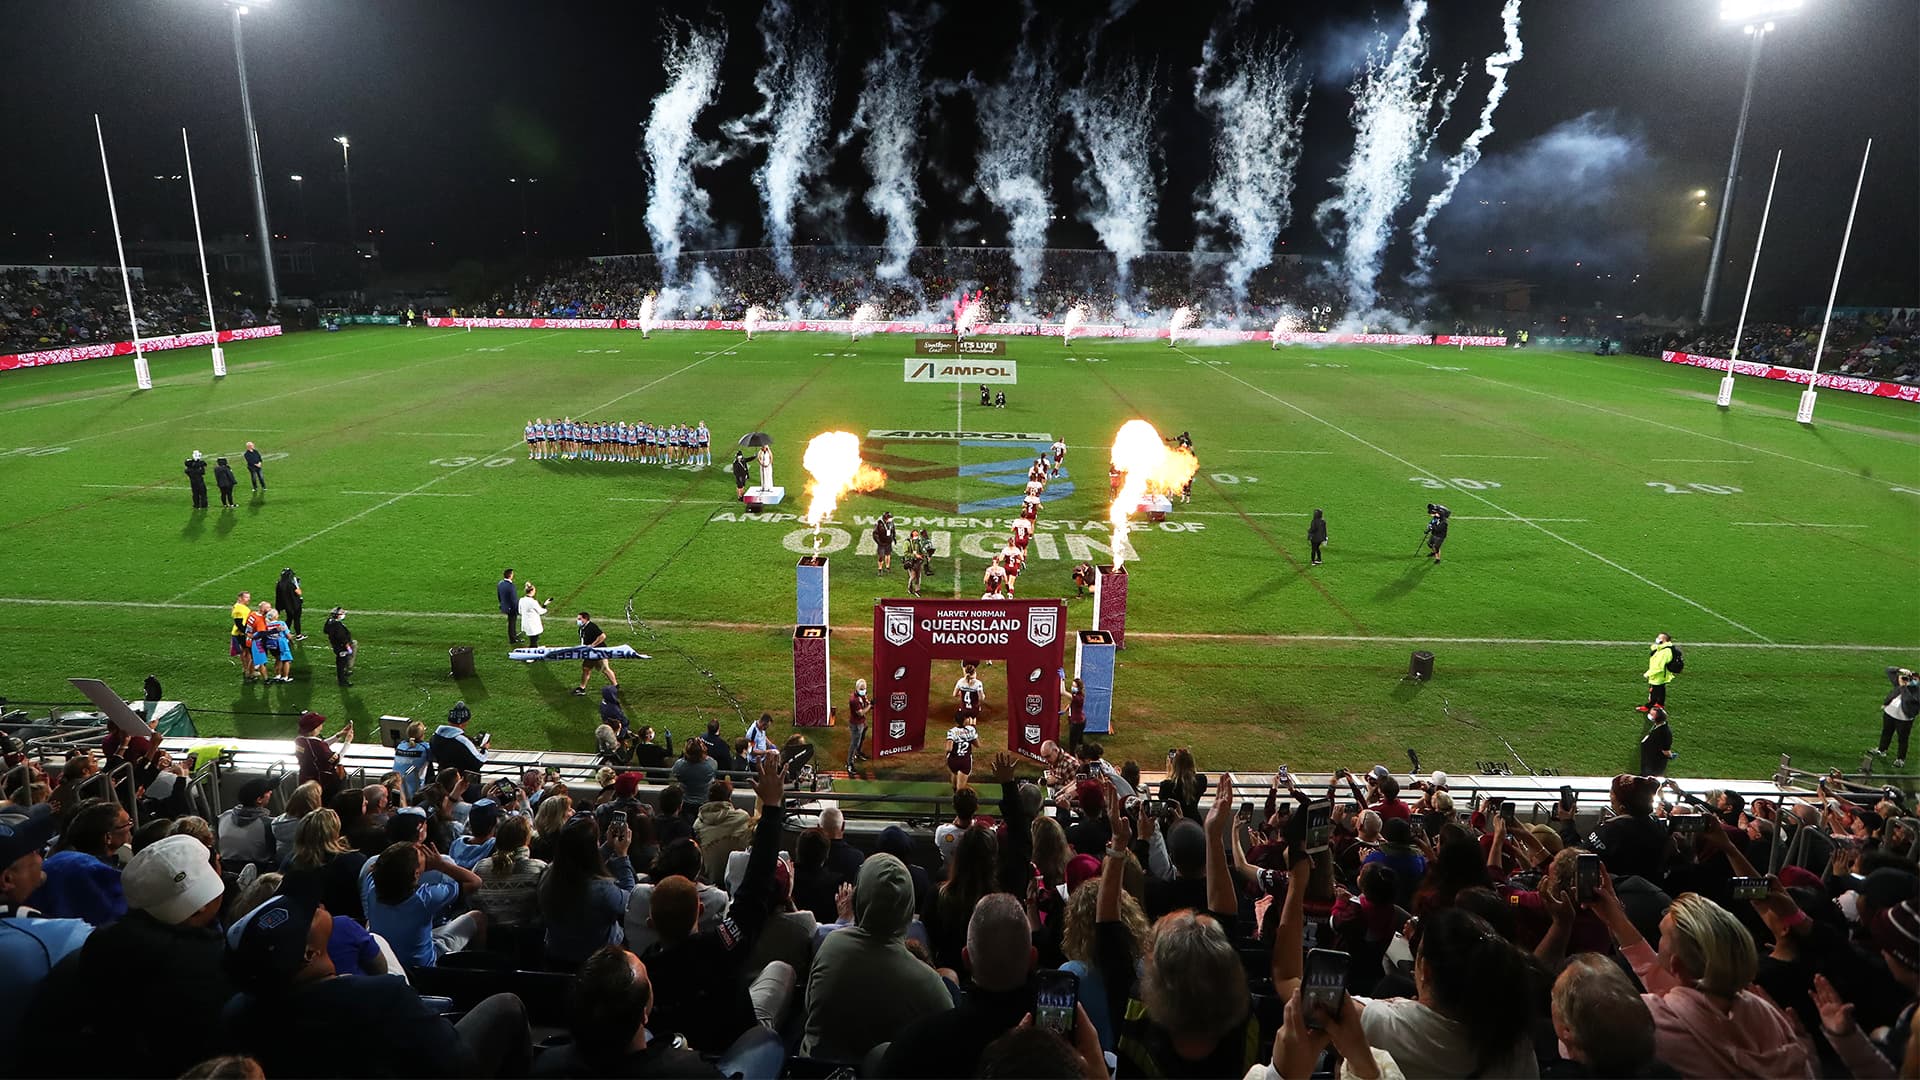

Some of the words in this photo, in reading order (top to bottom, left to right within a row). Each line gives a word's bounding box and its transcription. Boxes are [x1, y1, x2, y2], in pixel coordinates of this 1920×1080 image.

[940, 366, 1011, 377] AMPOL
[880, 431, 1041, 440] AMPOL
[853, 514, 1017, 529] WOMEN'S
[1159, 521, 1206, 533] OF
[782, 527, 1141, 562] ORIGIN
[937, 610, 969, 618] HARVEY
[970, 610, 1006, 618] NORMAN
[921, 619, 1021, 632] QUEENSLAND
[932, 632, 1009, 645] MAROONS
[963, 691, 971, 705] 4
[956, 741, 970, 754] 12
